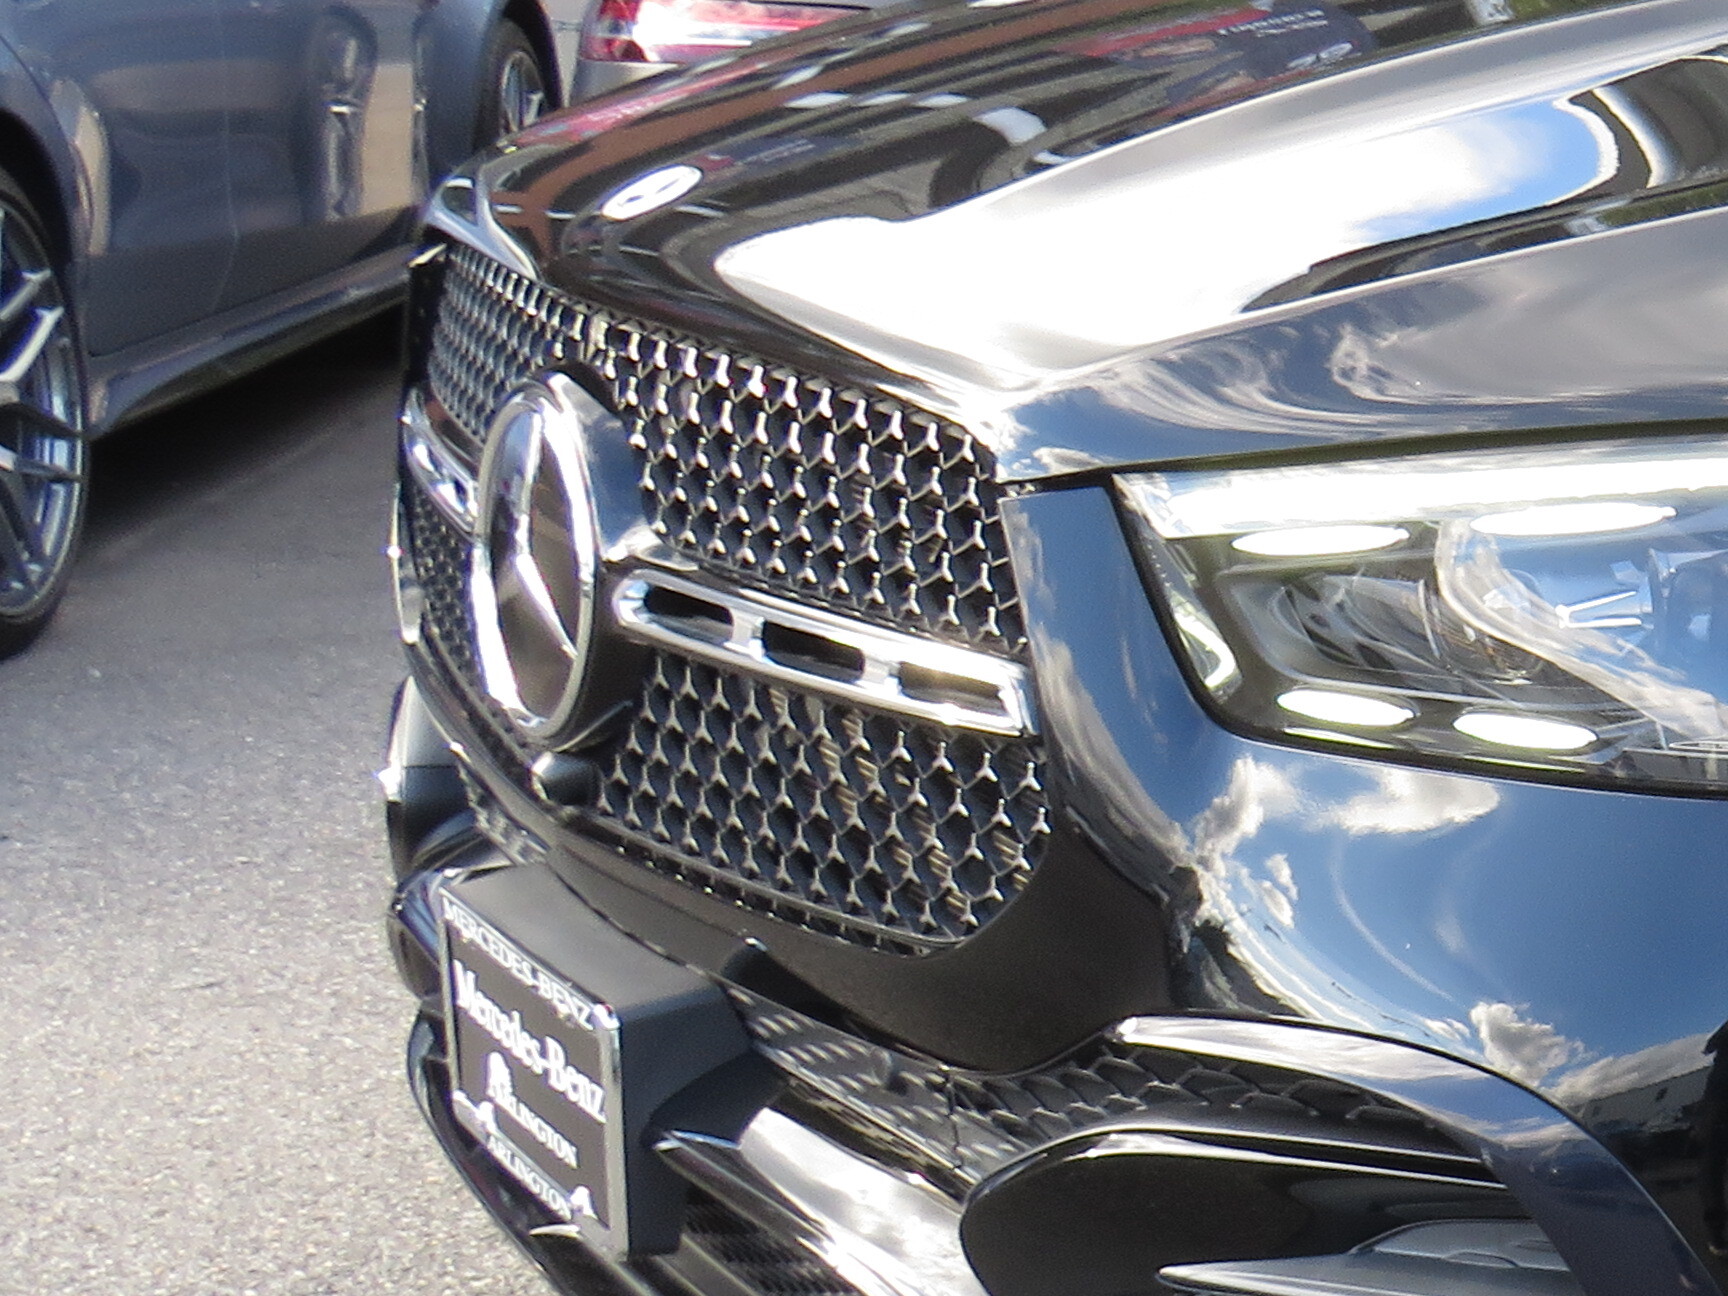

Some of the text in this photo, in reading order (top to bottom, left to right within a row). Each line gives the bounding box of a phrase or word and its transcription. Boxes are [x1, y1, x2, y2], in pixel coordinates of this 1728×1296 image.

[442, 896, 595, 1032] MERCEDES-BENZ
[452, 959, 607, 1124] Mercedes-Benz
[486, 1074, 578, 1169] ARLINGTON
[486, 1134, 572, 1221] ARLINGTON
